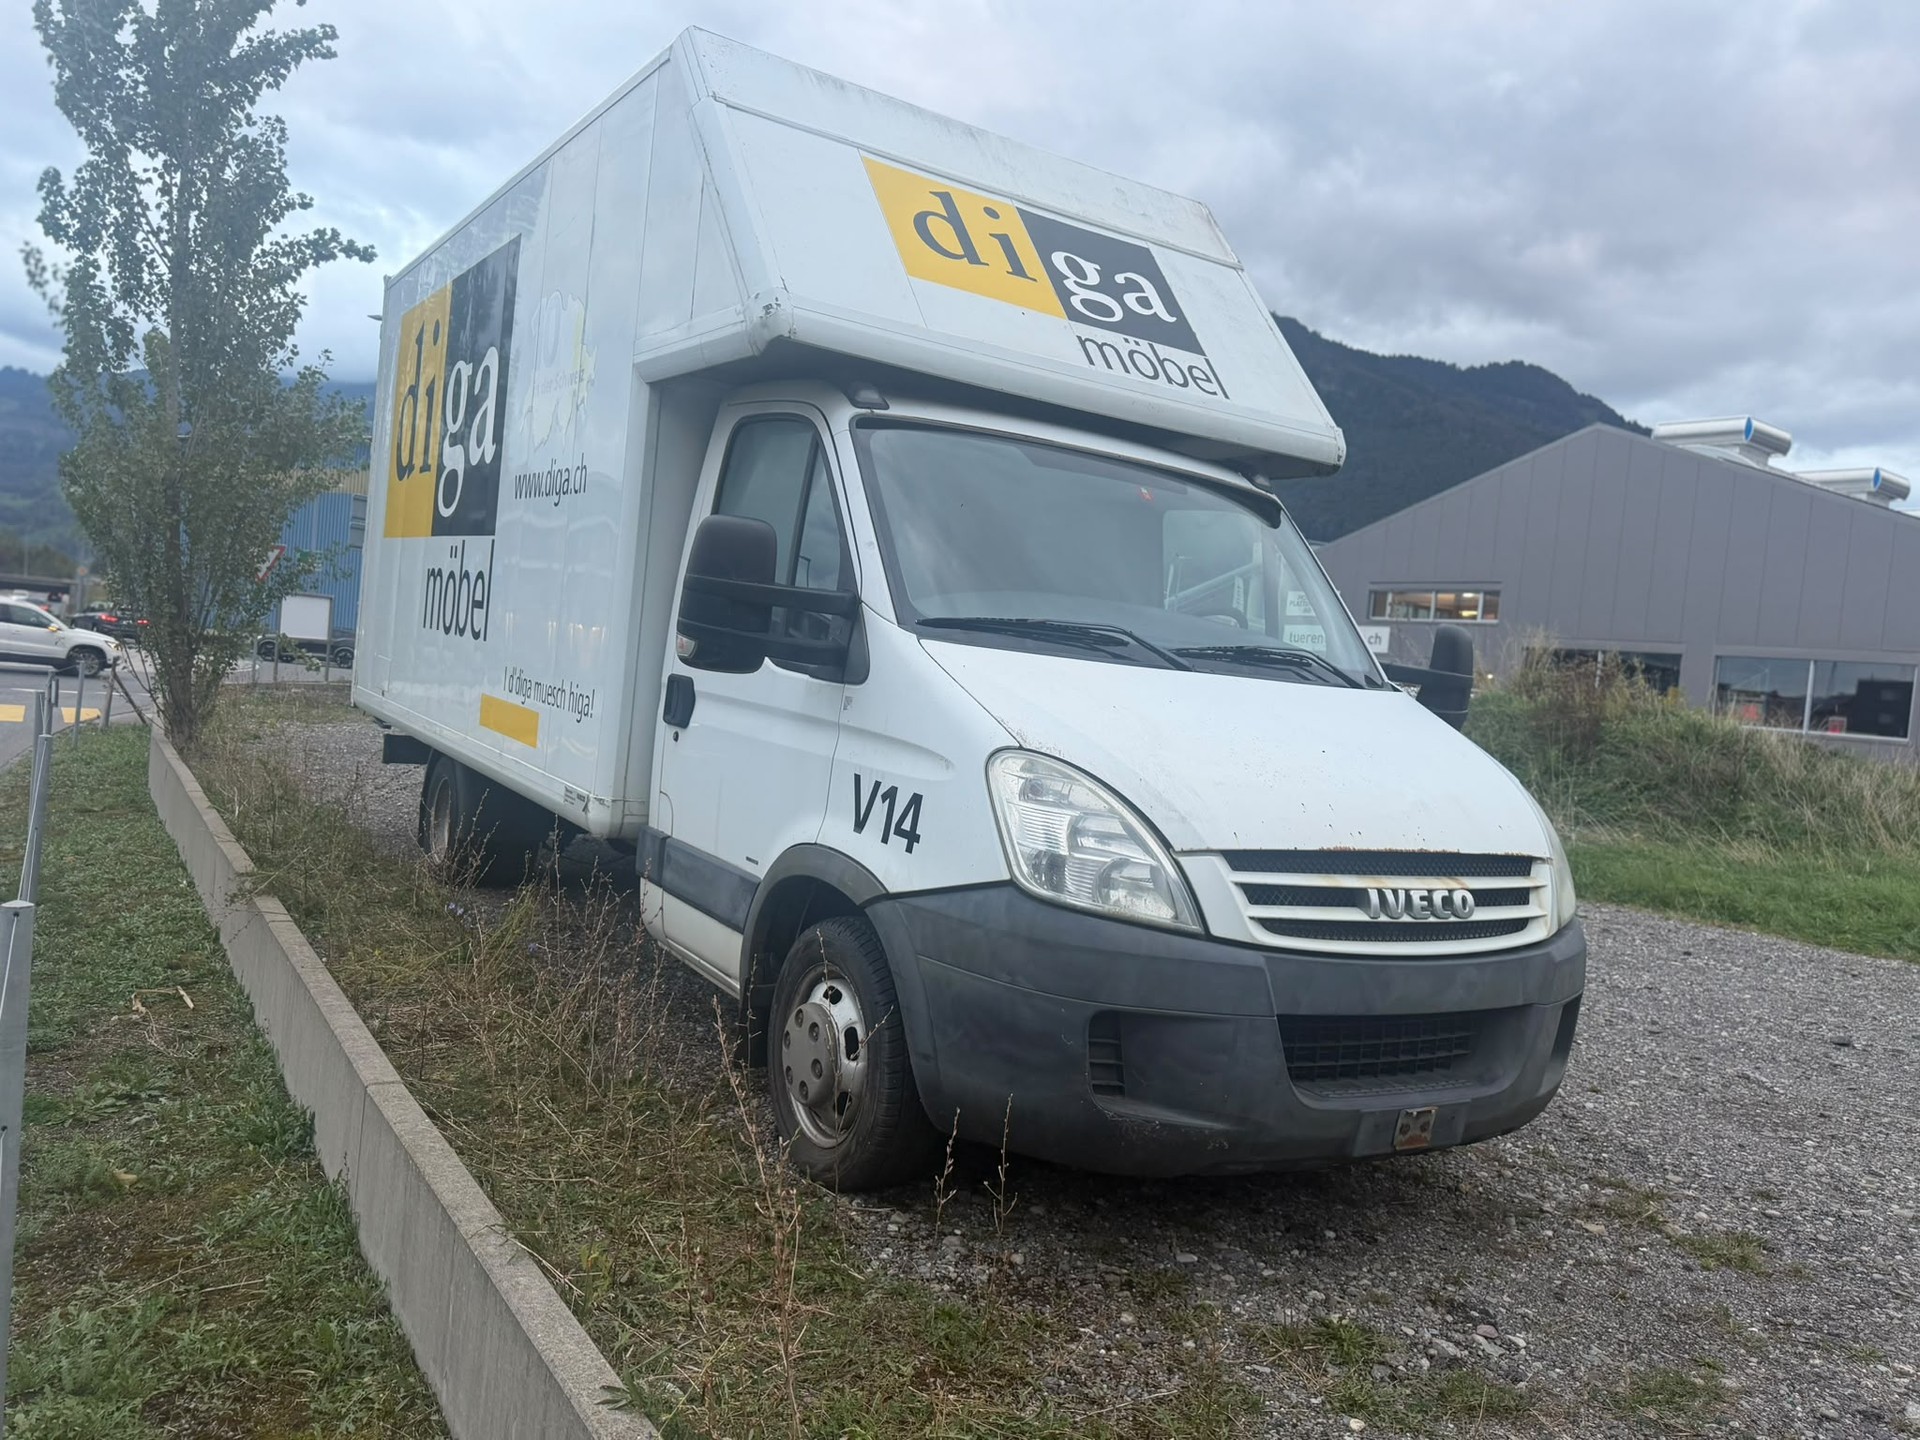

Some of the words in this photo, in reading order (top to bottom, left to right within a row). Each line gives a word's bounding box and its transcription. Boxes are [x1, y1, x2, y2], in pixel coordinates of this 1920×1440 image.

[912, 190, 1177, 322] diga
[1076, 333, 1230, 400] möbel
[396, 318, 499, 518] diga
[514, 452, 588, 507] www.diga.ch
[423, 538, 495, 642] möbel
[533, 679, 566, 711] muesch
[567, 681, 596, 723] higa!
[853, 772, 924, 854] V14
[1366, 888, 1475, 919] IVECO
